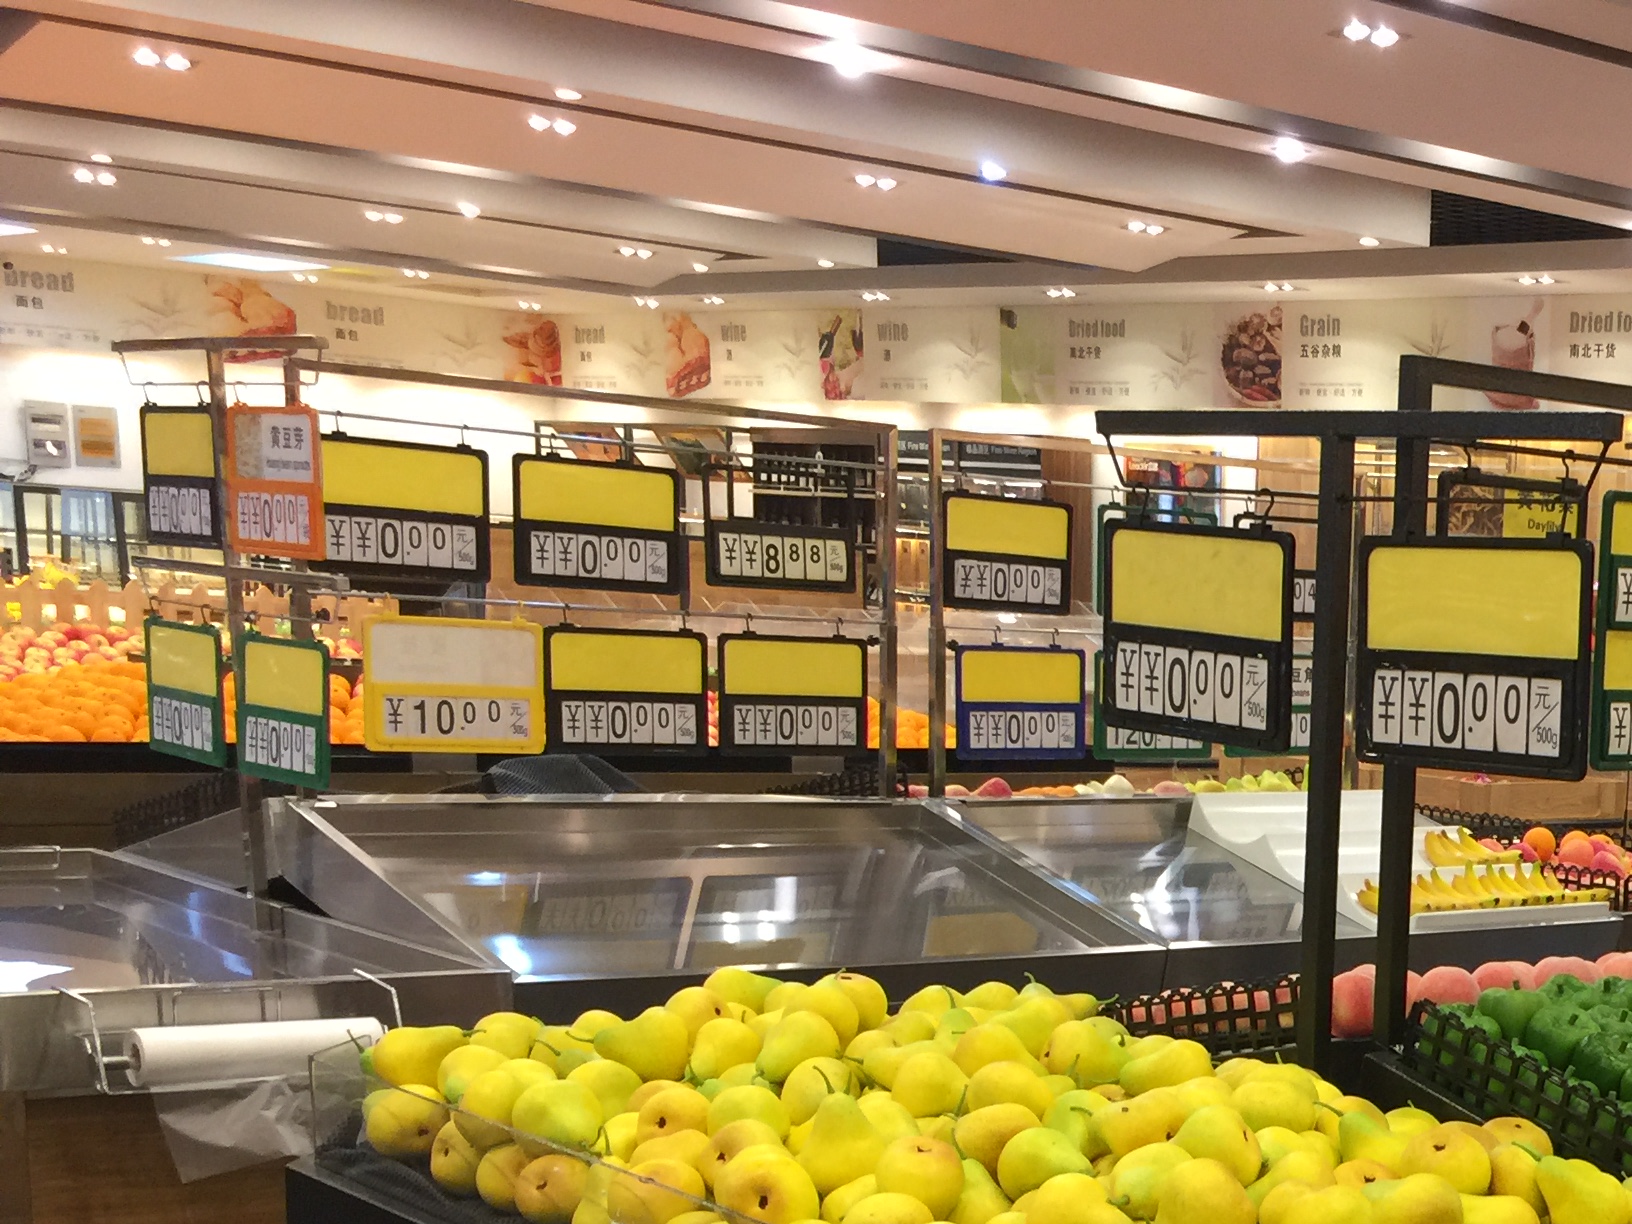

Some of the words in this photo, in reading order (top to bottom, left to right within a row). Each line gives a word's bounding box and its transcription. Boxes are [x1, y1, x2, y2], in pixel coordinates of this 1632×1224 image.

[326, 301, 385, 327] bread
[1068, 319, 1099, 339] Dried
[1101, 318, 1126, 338] food
[1299, 314, 1341, 337] Grain
[1569, 311, 1614, 334] Dried
[1299, 343, 1342, 359] 五谷杂粮
[1569, 343, 1617, 359] 南北干货
[327, 519, 446, 558] ¥¥0.00
[533, 533, 641, 575] ¥¥0.00
[960, 565, 1040, 598] ¥¥0.00
[1120, 649, 1234, 714] ¥¥0.00
[1244, 664, 1266, 723] 元/500g
[386, 698, 501, 736] ¥10.00
[564, 704, 670, 739] ¥¥0.00
[736, 707, 832, 741] ¥¥0.00
[1377, 675, 1521, 744] ¥¥0.00
[1532, 685, 1559, 750] 元/500g
[972, 714, 1055, 745] ¥¥0.00
